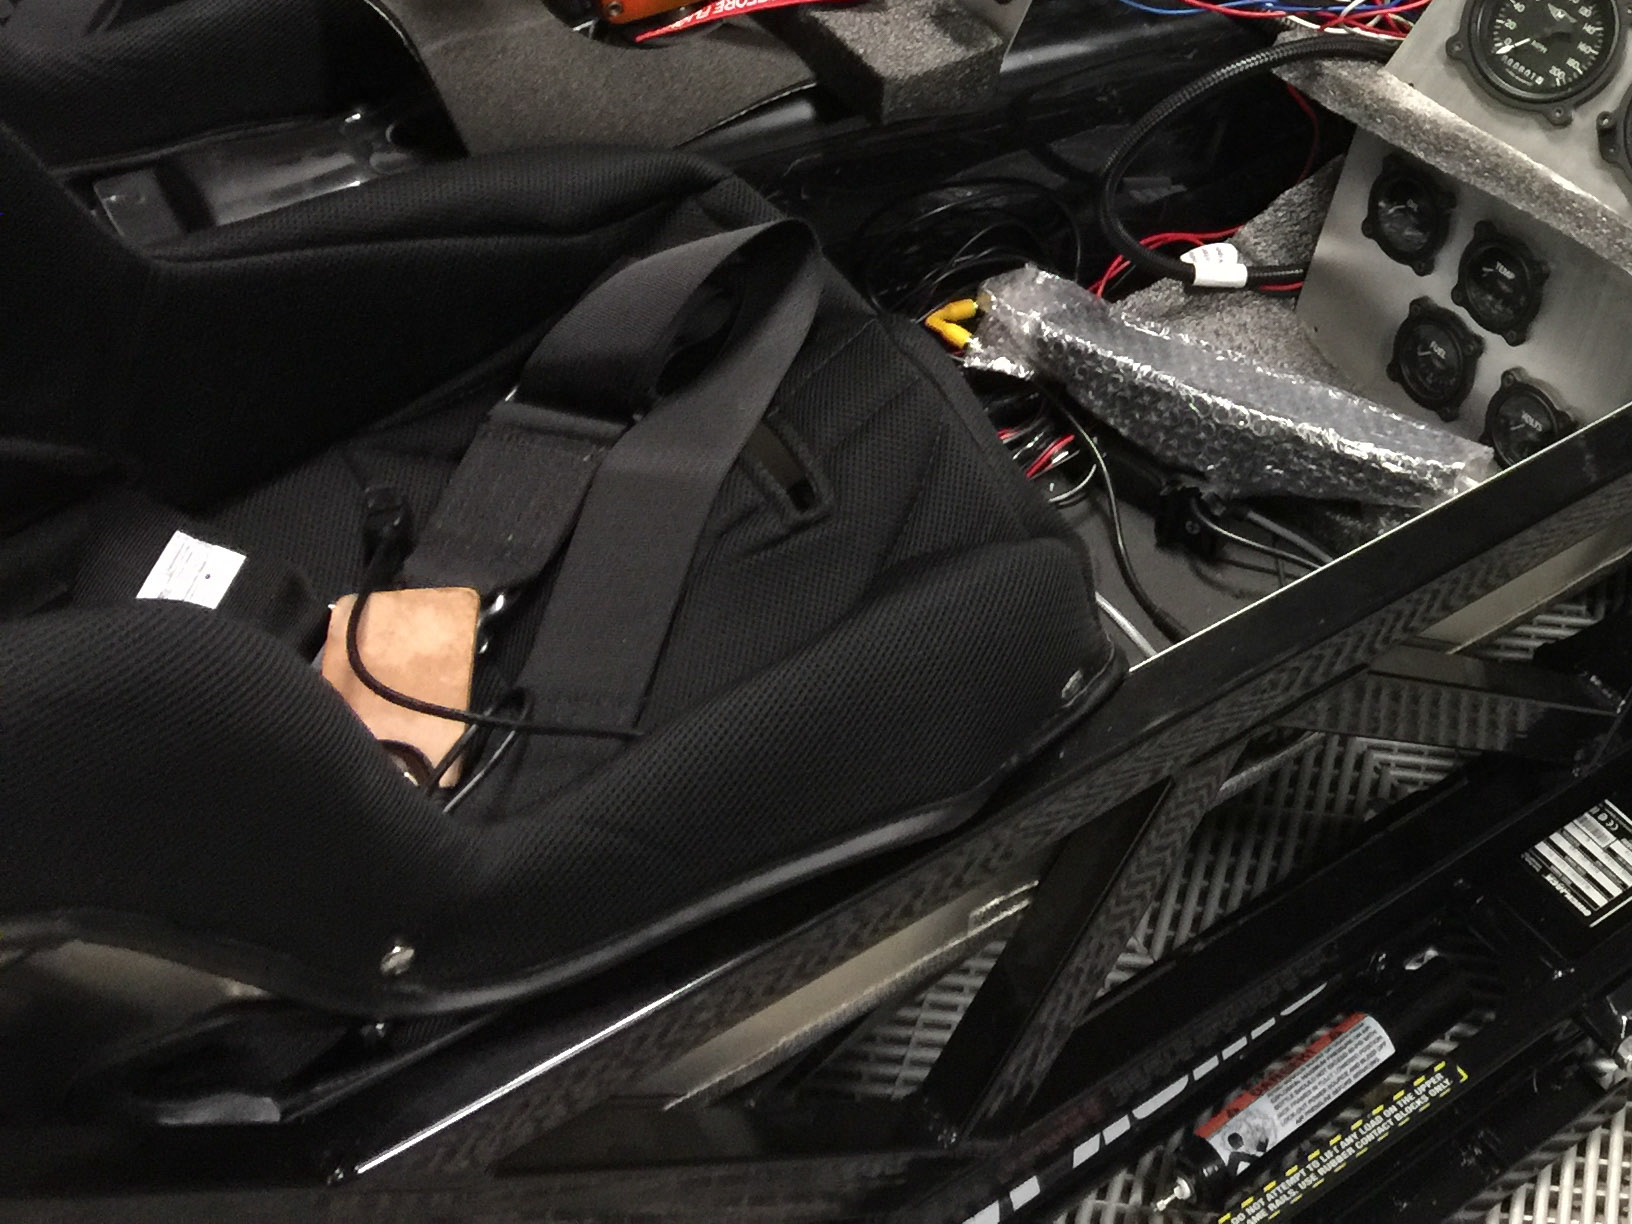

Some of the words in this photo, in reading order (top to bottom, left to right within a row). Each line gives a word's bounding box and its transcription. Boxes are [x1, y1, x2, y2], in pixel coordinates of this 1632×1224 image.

[1513, 2, 1526, 13] 40
[1504, 18, 1517, 30] 20
[1577, 41, 1592, 54] 160
[1429, 340, 1447, 360] FUEL
[1245, 1197, 1266, 1215] NOT
[1264, 1167, 1308, 1201] ATTEMPT
[1305, 1158, 1320, 1172] TO
[1318, 1144, 1340, 1163] LIFT
[1338, 1130, 1359, 1149] ANY
[1357, 1114, 1383, 1135] LOAD
[1382, 1104, 1398, 1118] ON
[1396, 1091, 1415, 1108] THE
[1413, 1071, 1444, 1096] UPPER
[1297, 1172, 1318, 1190] USE
[1316, 1145, 1355, 1176] RUBBER
[1354, 1118, 1394, 1150] CONTACT
[1393, 1093, 1429, 1121] BLOCKS
